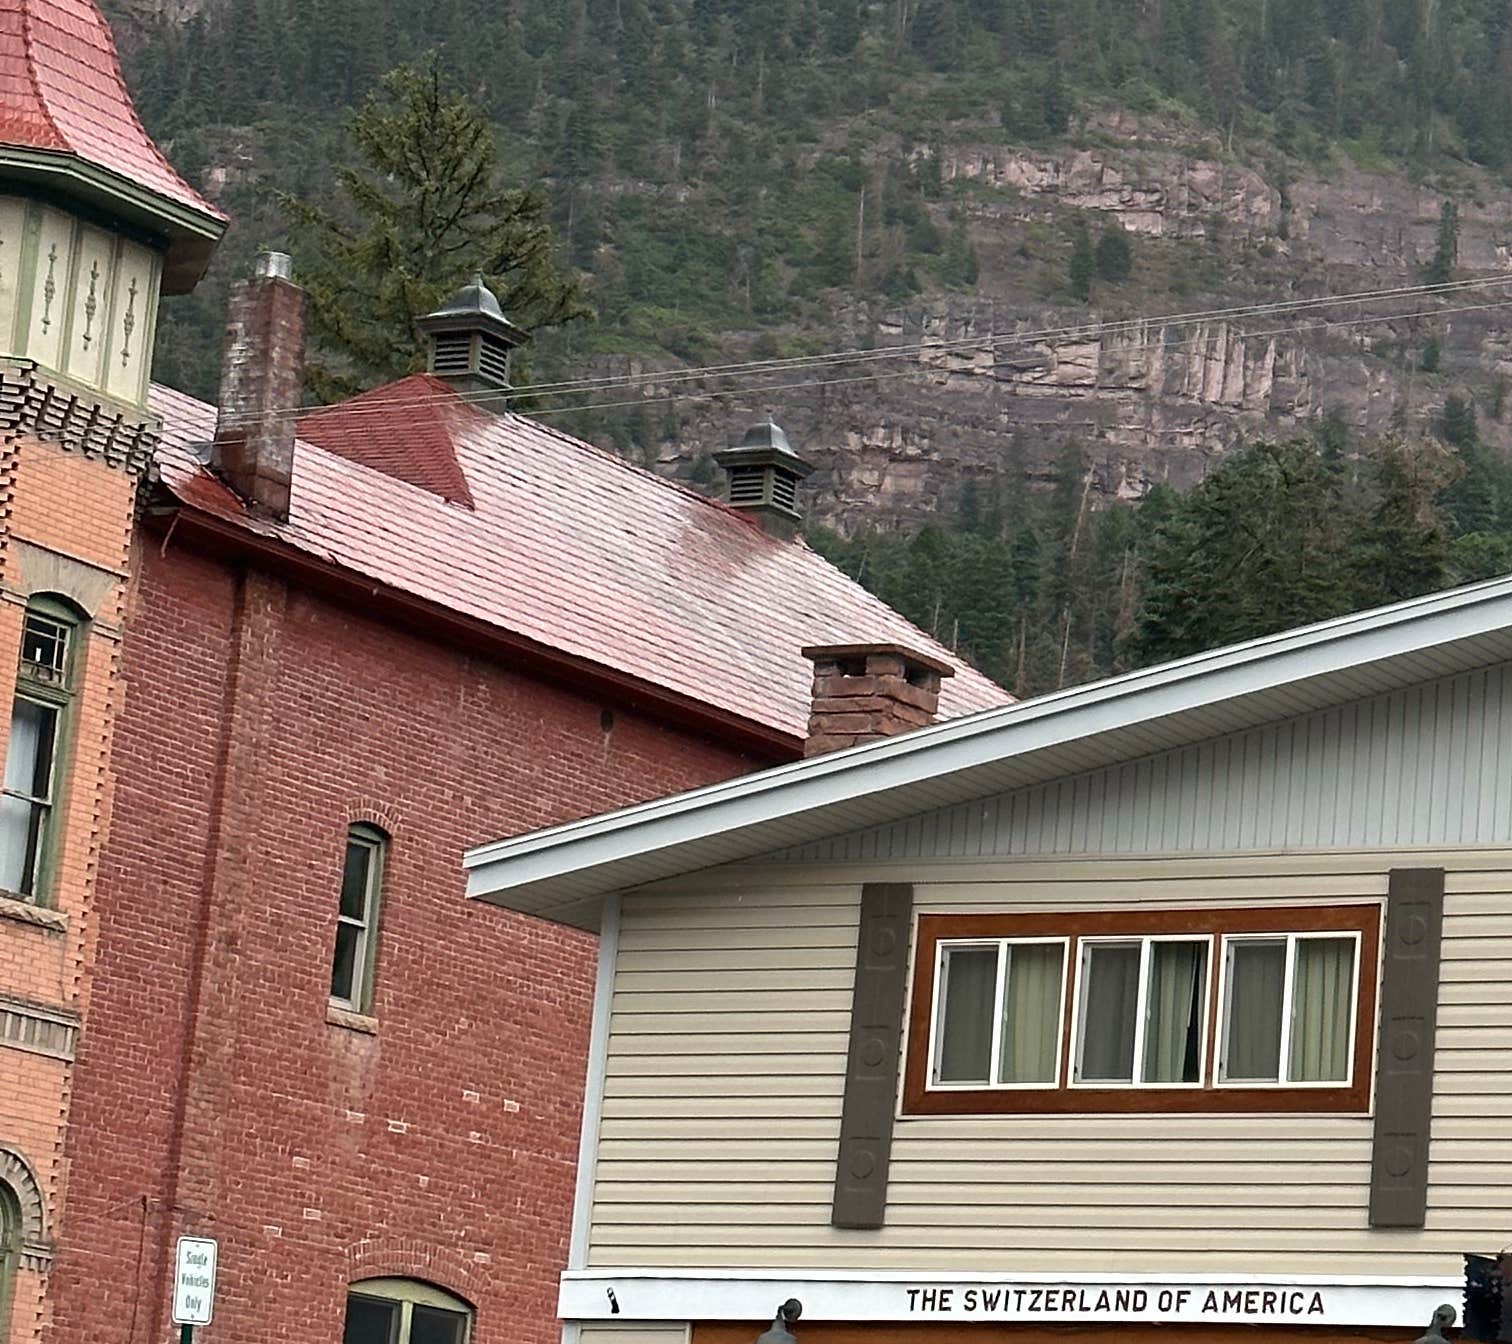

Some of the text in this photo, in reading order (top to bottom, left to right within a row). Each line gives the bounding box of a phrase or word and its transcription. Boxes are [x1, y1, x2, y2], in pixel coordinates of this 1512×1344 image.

[185, 1294, 202, 1312] Only
[906, 1289, 1325, 1316] THE SWITZERLAND OF AMERICA
